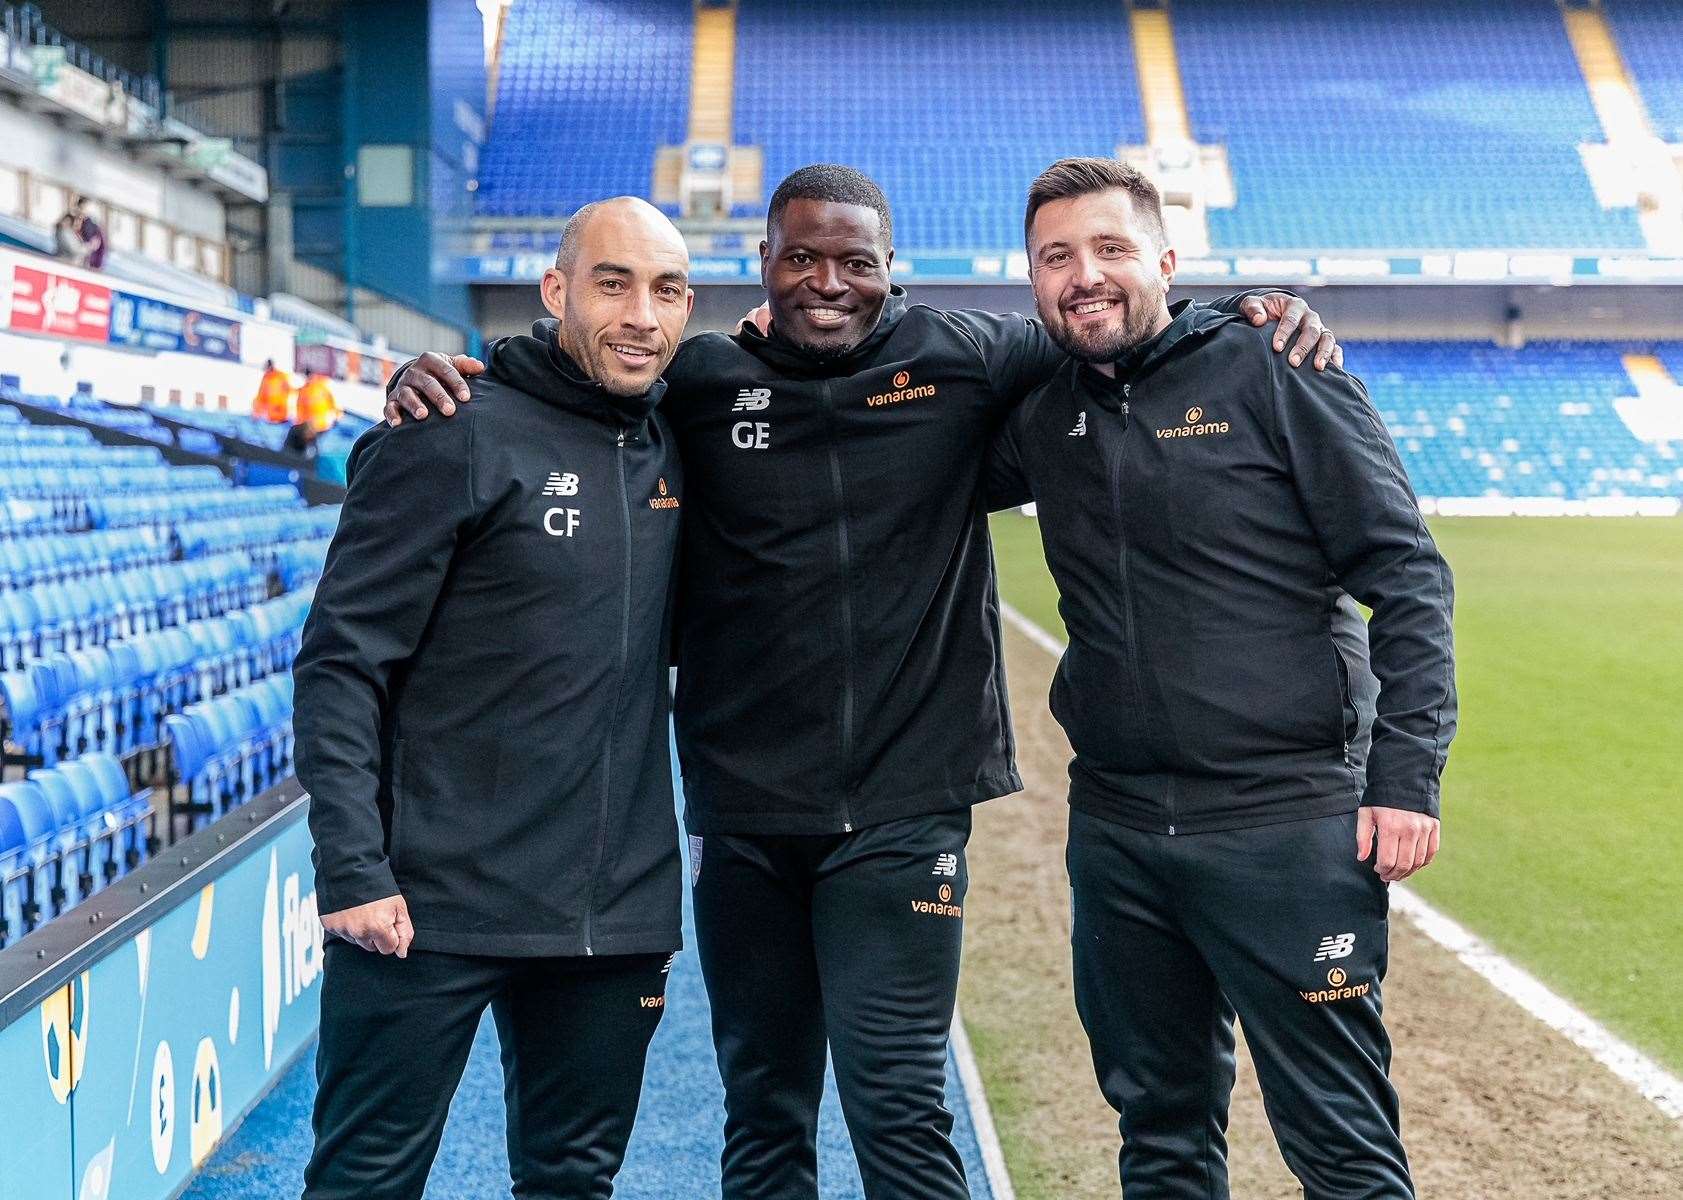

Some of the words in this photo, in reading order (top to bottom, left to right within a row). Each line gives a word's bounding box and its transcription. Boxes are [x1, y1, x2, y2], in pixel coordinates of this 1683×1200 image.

[867, 385, 936, 407] vanarama
[731, 421, 770, 450] GE
[1156, 421, 1229, 439] vanarama
[543, 507, 581, 537] CF
